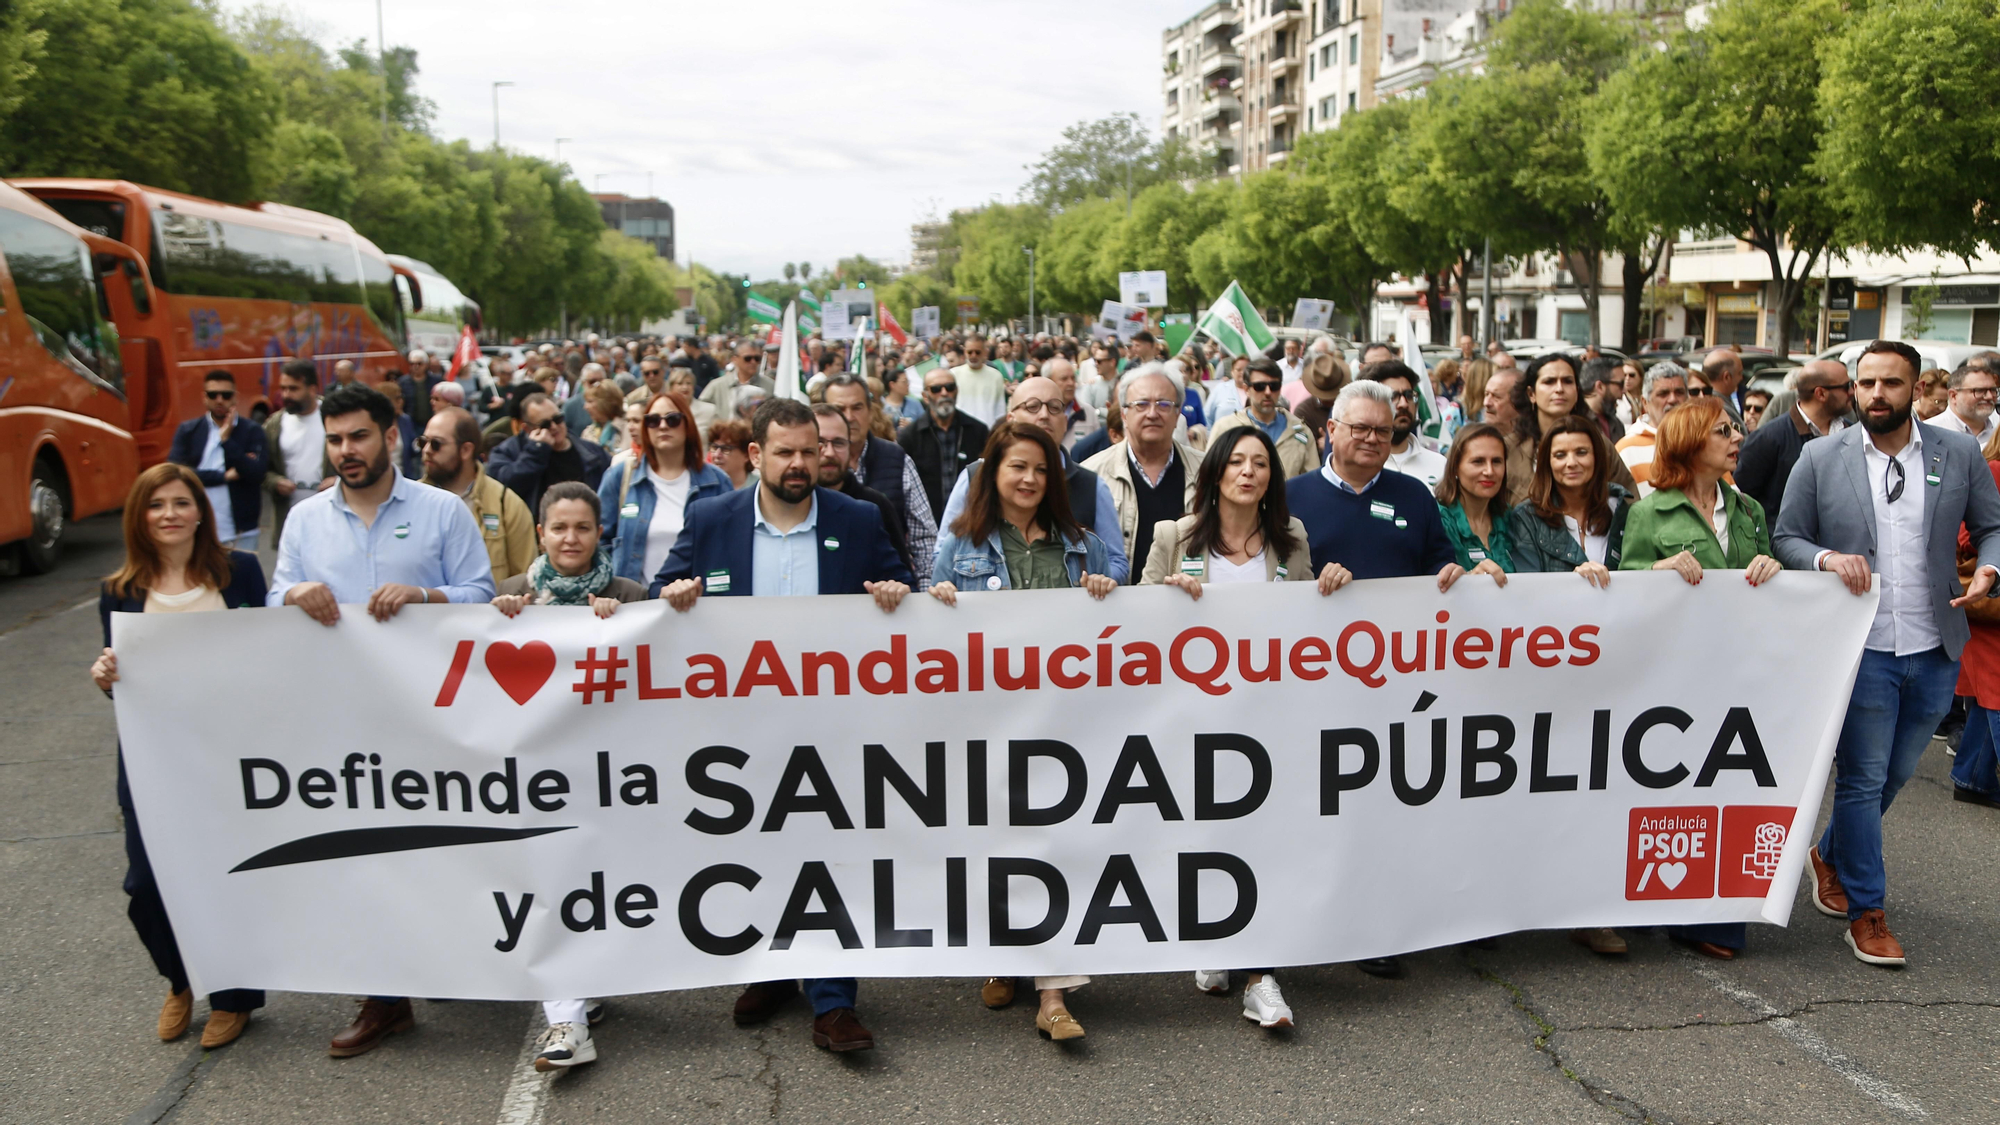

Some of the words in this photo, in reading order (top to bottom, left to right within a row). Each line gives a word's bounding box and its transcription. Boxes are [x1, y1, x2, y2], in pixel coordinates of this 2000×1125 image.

[572, 610, 1601, 706] #LaAndalucíaQueQuieres
[240, 752, 570, 814] Defiende
[597, 751, 659, 809] la
[683, 735, 1273, 836] SANIDAD
[1319, 690, 1778, 816] PÚBLICA
[1637, 832, 1706, 860] PSOE
[1639, 815, 1707, 831] Andalucía
[493, 891, 534, 953] y
[560, 871, 658, 934] de
[678, 851, 1258, 956] CALIDAD
